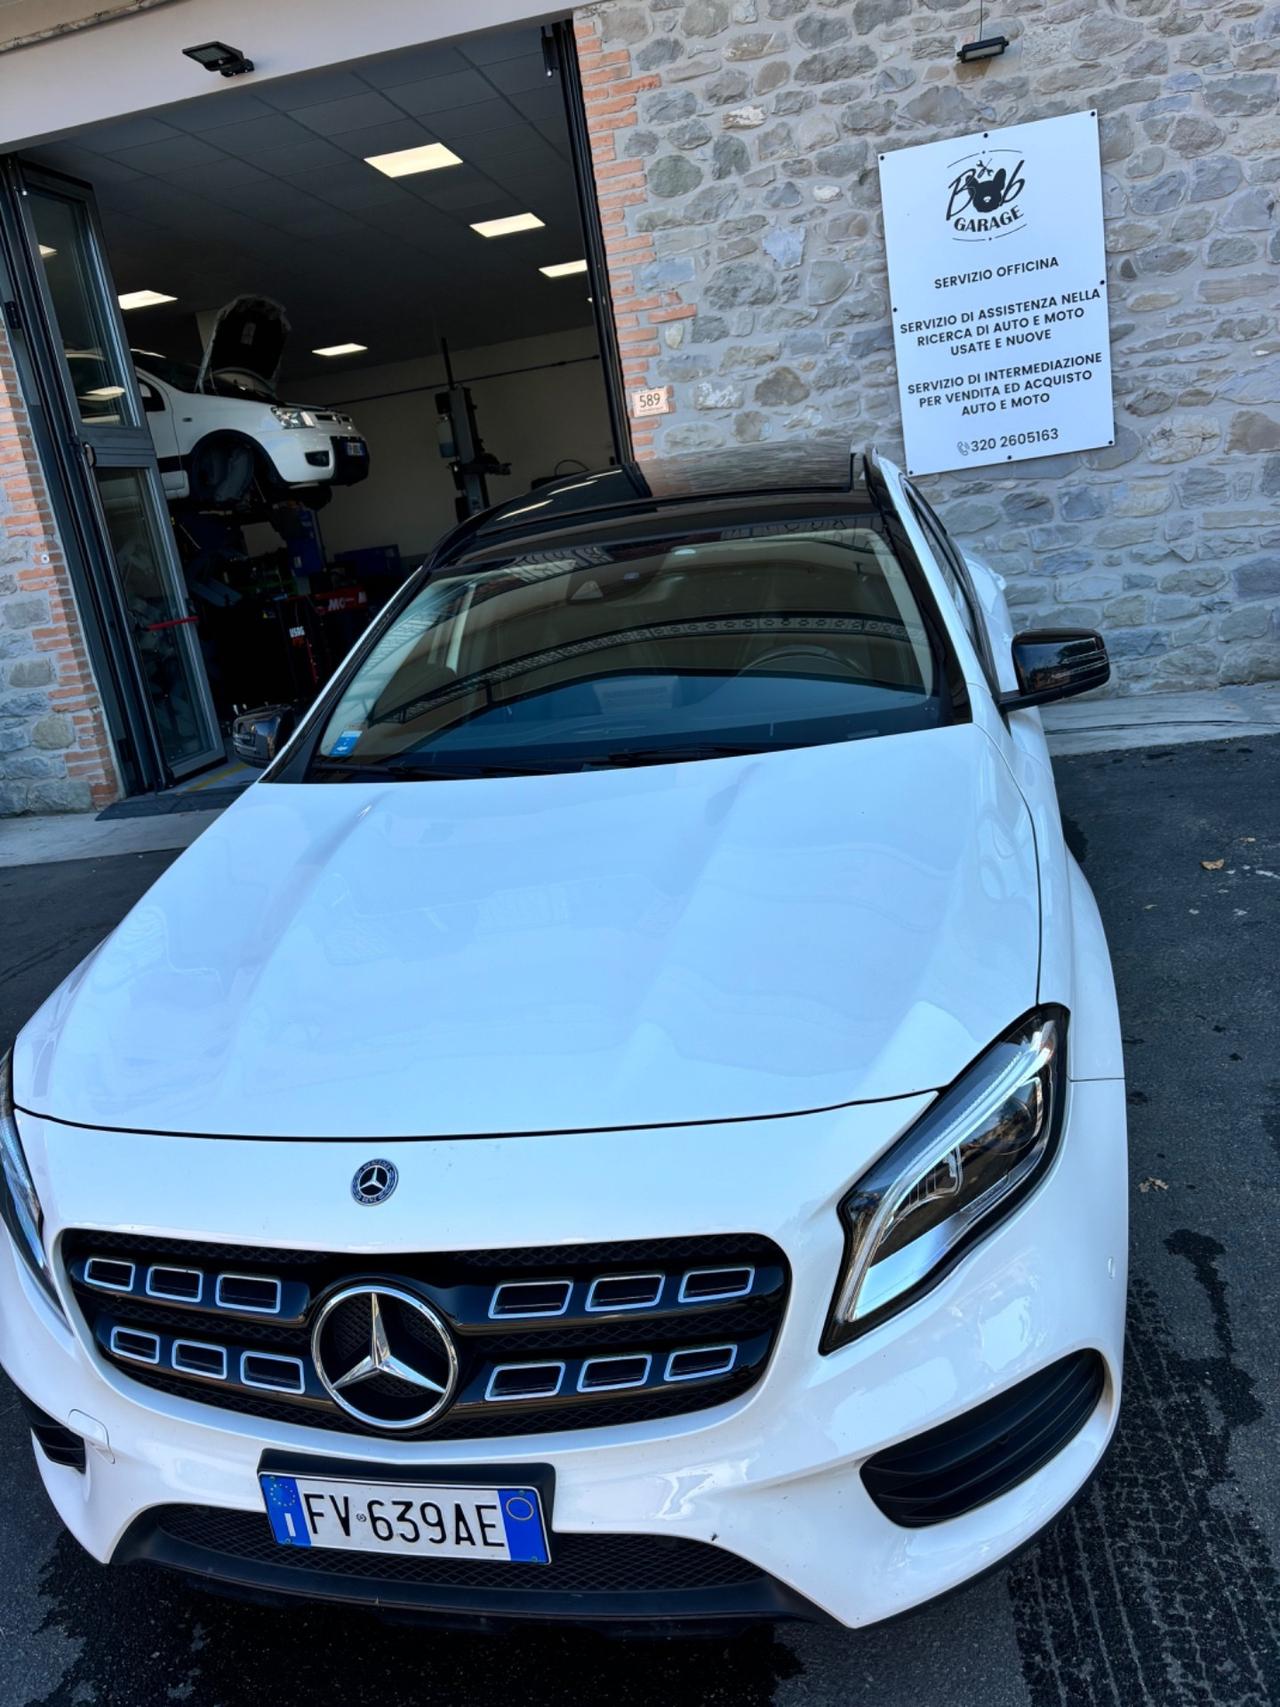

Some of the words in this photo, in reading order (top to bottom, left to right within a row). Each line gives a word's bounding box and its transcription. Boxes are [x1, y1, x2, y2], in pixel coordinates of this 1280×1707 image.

[954, 205, 1024, 233] GARAGE
[934, 269, 993, 290] SERVIZIO
[997, 256, 1059, 278] OFFICINA
[900, 314, 957, 334] SERVIZIO
[962, 311, 974, 323] DI
[978, 297, 1058, 320] ASSISTENZA
[1061, 288, 1101, 305] NELLA
[917, 328, 973, 347] RICERCA
[977, 325, 989, 337] DI
[993, 318, 1030, 333] AUTO
[1033, 315, 1040, 325] E
[1044, 307, 1085, 324] MOTO
[950, 341, 991, 356] USATE
[995, 338, 1002, 349] E
[1006, 329, 1052, 346] NUOVE
[908, 376, 964, 395] SERVIZIO
[968, 373, 981, 385] DI
[985, 352, 1102, 382] INTERMEDIAZIONE
[920, 396, 942, 408] PER
[945, 385, 1000, 404] VENDITA
[1004, 382, 1020, 393] ED
[1025, 370, 1093, 391] ACQUISTO
[640, 392, 661, 408] 589
[961, 402, 996, 416] AUTO
[1001, 399, 1007, 410] E
[1011, 393, 1050, 409] MOTO
[971, 438, 997, 453] 320
[1000, 428, 1059, 448] 2605163
